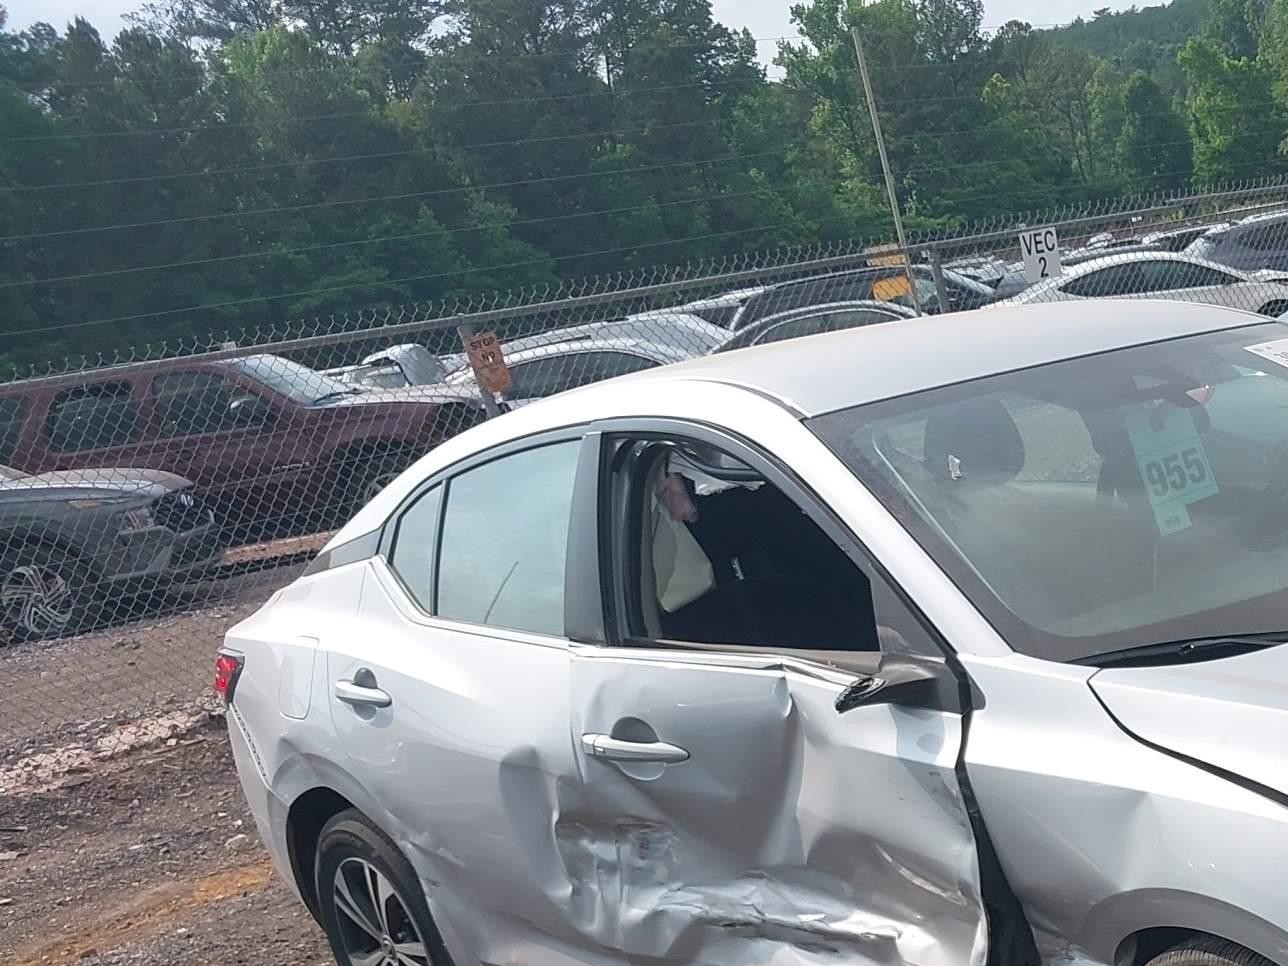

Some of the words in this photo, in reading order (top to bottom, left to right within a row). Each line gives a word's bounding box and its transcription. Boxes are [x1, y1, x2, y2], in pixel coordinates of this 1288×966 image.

[1021, 230, 1056, 256] VEC
[1038, 256, 1050, 278] 2
[470, 336, 496, 351] STOP
[1146, 447, 1206, 498] 955
